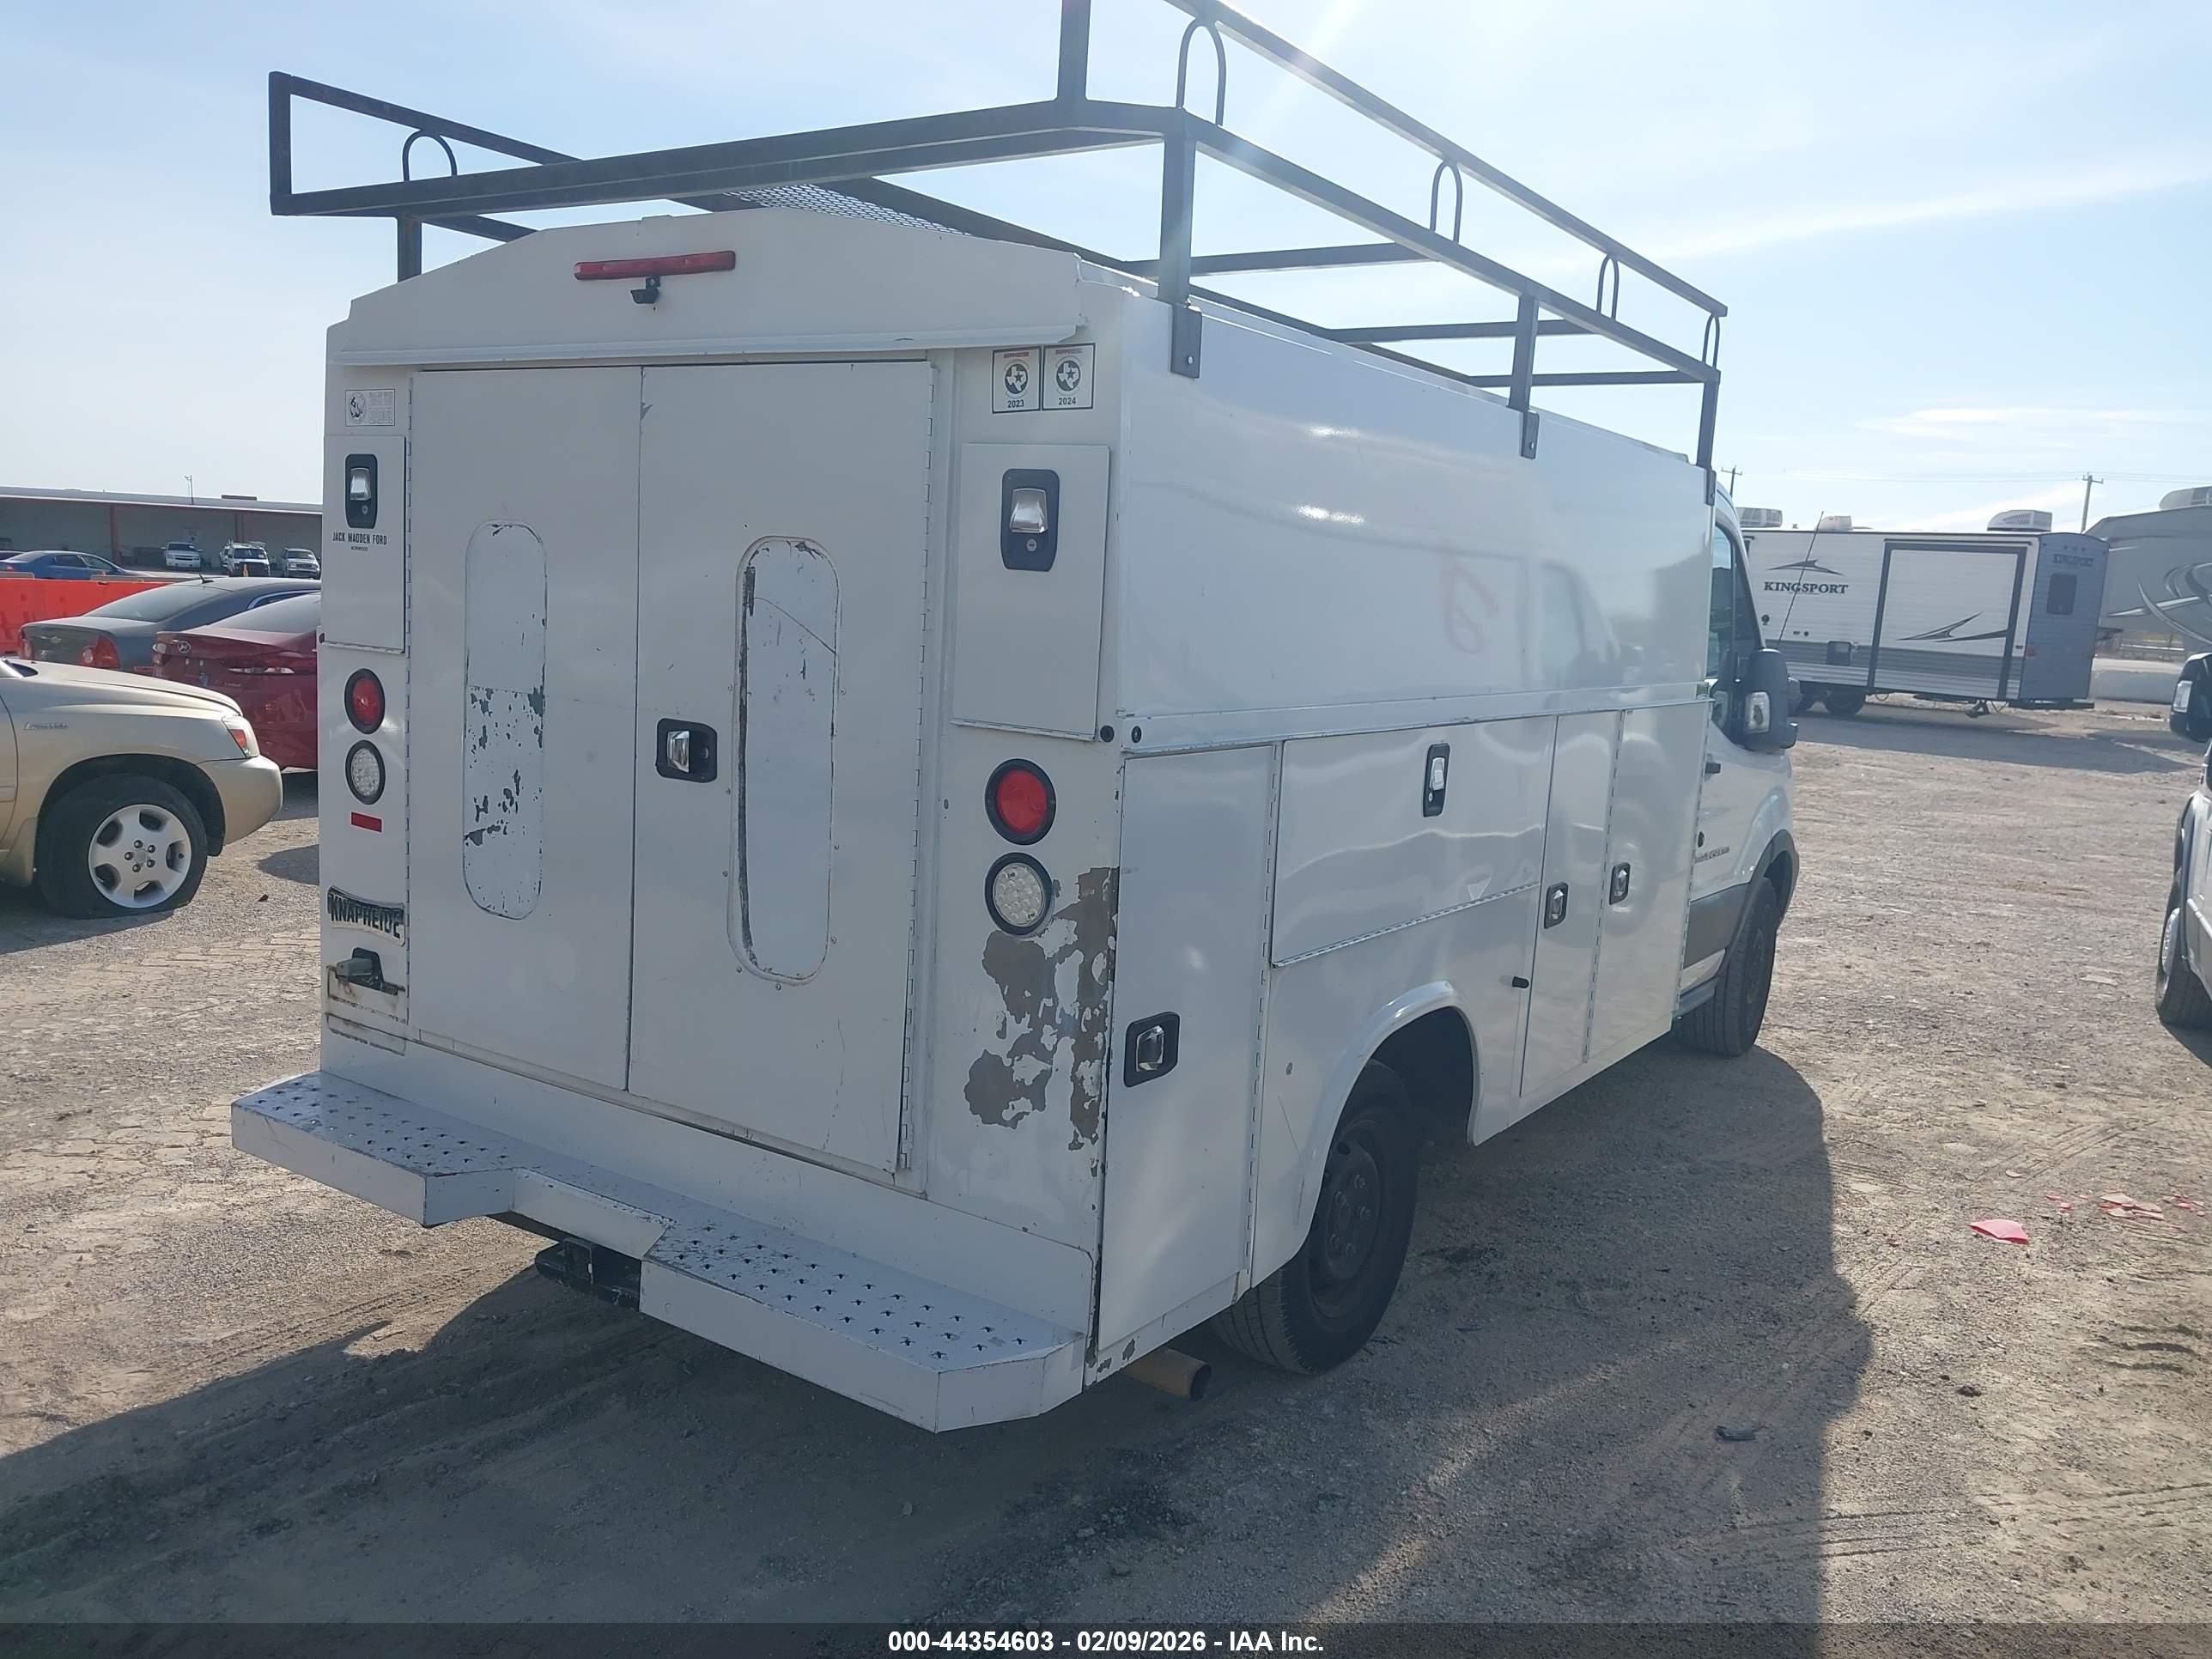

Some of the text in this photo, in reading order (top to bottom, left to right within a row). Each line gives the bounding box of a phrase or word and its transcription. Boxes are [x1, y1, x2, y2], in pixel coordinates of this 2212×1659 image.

[1007, 399, 1024, 408] 2023
[1058, 397, 1077, 405] 2024
[332, 532, 387, 545] JACK MADDEN FORD
[1764, 581, 1849, 594] KINGSPORT
